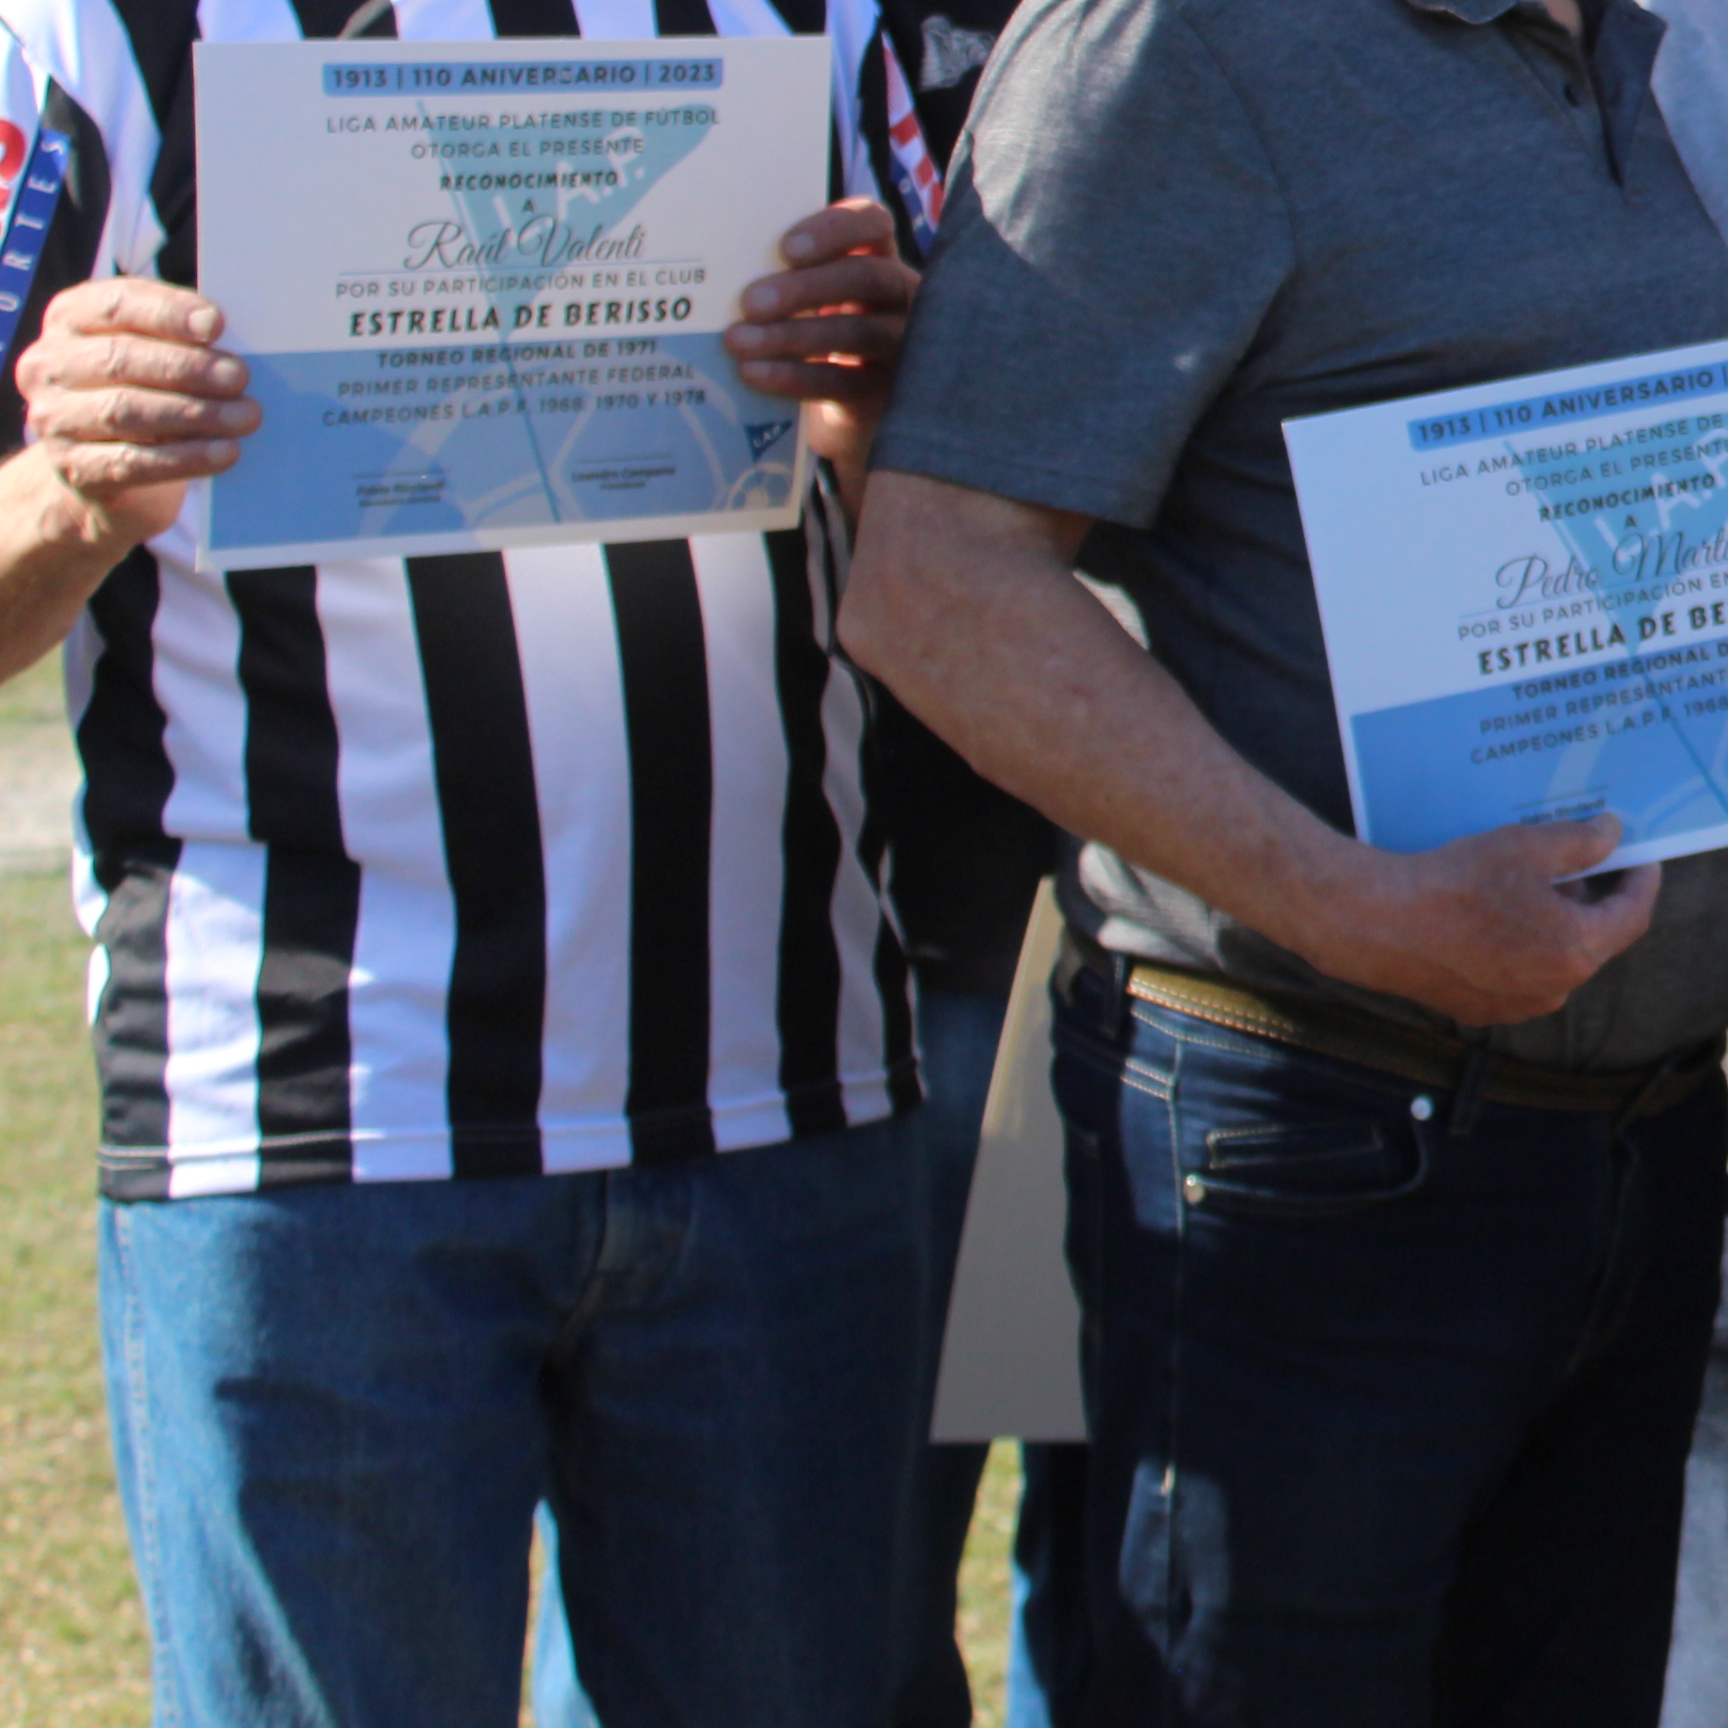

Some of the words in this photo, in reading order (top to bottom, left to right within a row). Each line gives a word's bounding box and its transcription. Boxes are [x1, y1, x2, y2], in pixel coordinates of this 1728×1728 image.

[332, 67, 387, 88] 1913
[413, 67, 451, 87] 110
[461, 64, 636, 86] ANIVERSARIO
[658, 63, 716, 83] 2023
[326, 115, 376, 133] LIGA
[385, 113, 491, 132] AMATEUR
[498, 111, 604, 130] PLATENSE
[610, 110, 638, 128] DE
[411, 140, 500, 159] OTORGA
[508, 139, 532, 157] EL
[539, 136, 646, 156] PRESENTE
[440, 168, 620, 192] RECONOCIMIENTO
[520, 197, 536, 213] A
[403, 218, 508, 271] Raúl
[517, 213, 648, 268] Valenti
[336, 280, 379, 299] POR
[388, 278, 417, 296] SU
[591, 271, 621, 289] EN
[626, 270, 649, 287] EL
[654, 266, 707, 285] CLUB
[350, 305, 501, 336] ESTRELLA
[514, 303, 552, 329] DE
[563, 296, 694, 327] BERISSO
[378, 349, 463, 369] TORNEO
[471, 343, 579, 365] REGIONAL
[582, 342, 610, 359] DE
[615, 338, 658, 356] 1971
[337, 377, 419, 398] PRIMER
[426, 369, 601, 395] REPRESENTANTE
[606, 363, 695, 384] FEDERAL
[322, 402, 454, 428] CAMPEONES
[595, 391, 640, 411] 1970
[644, 390, 658, 408] Y
[663, 387, 707, 406] 1978
[1417, 414, 1472, 443] 1913
[1493, 403, 1533, 428] 110
[1539, 368, 1715, 419] ANIVERSARIO
[1418, 461, 1470, 487] LIGA
[1475, 440, 1580, 476] AMATEUR
[1584, 419, 1691, 454] PLATENSE
[1696, 412, 1726, 433] DE
[1504, 464, 1593, 497] OTORGA
[1598, 457, 1625, 479] EL
[1537, 470, 1719, 523] RECONOCIMIENTO
[1621, 512, 1639, 530] A
[1495, 546, 1601, 609] Pedro
[1457, 617, 1502, 642] POR
[1507, 609, 1538, 631] SU
[1476, 621, 1628, 675] ESTRELLA
[1637, 610, 1678, 641] DE
[1511, 668, 1598, 701] TORNEO
[1602, 644, 1714, 683] REGIONAL
[1477, 703, 1561, 736] PRIMER
[1467, 722, 1601, 766] CAMPEONES
